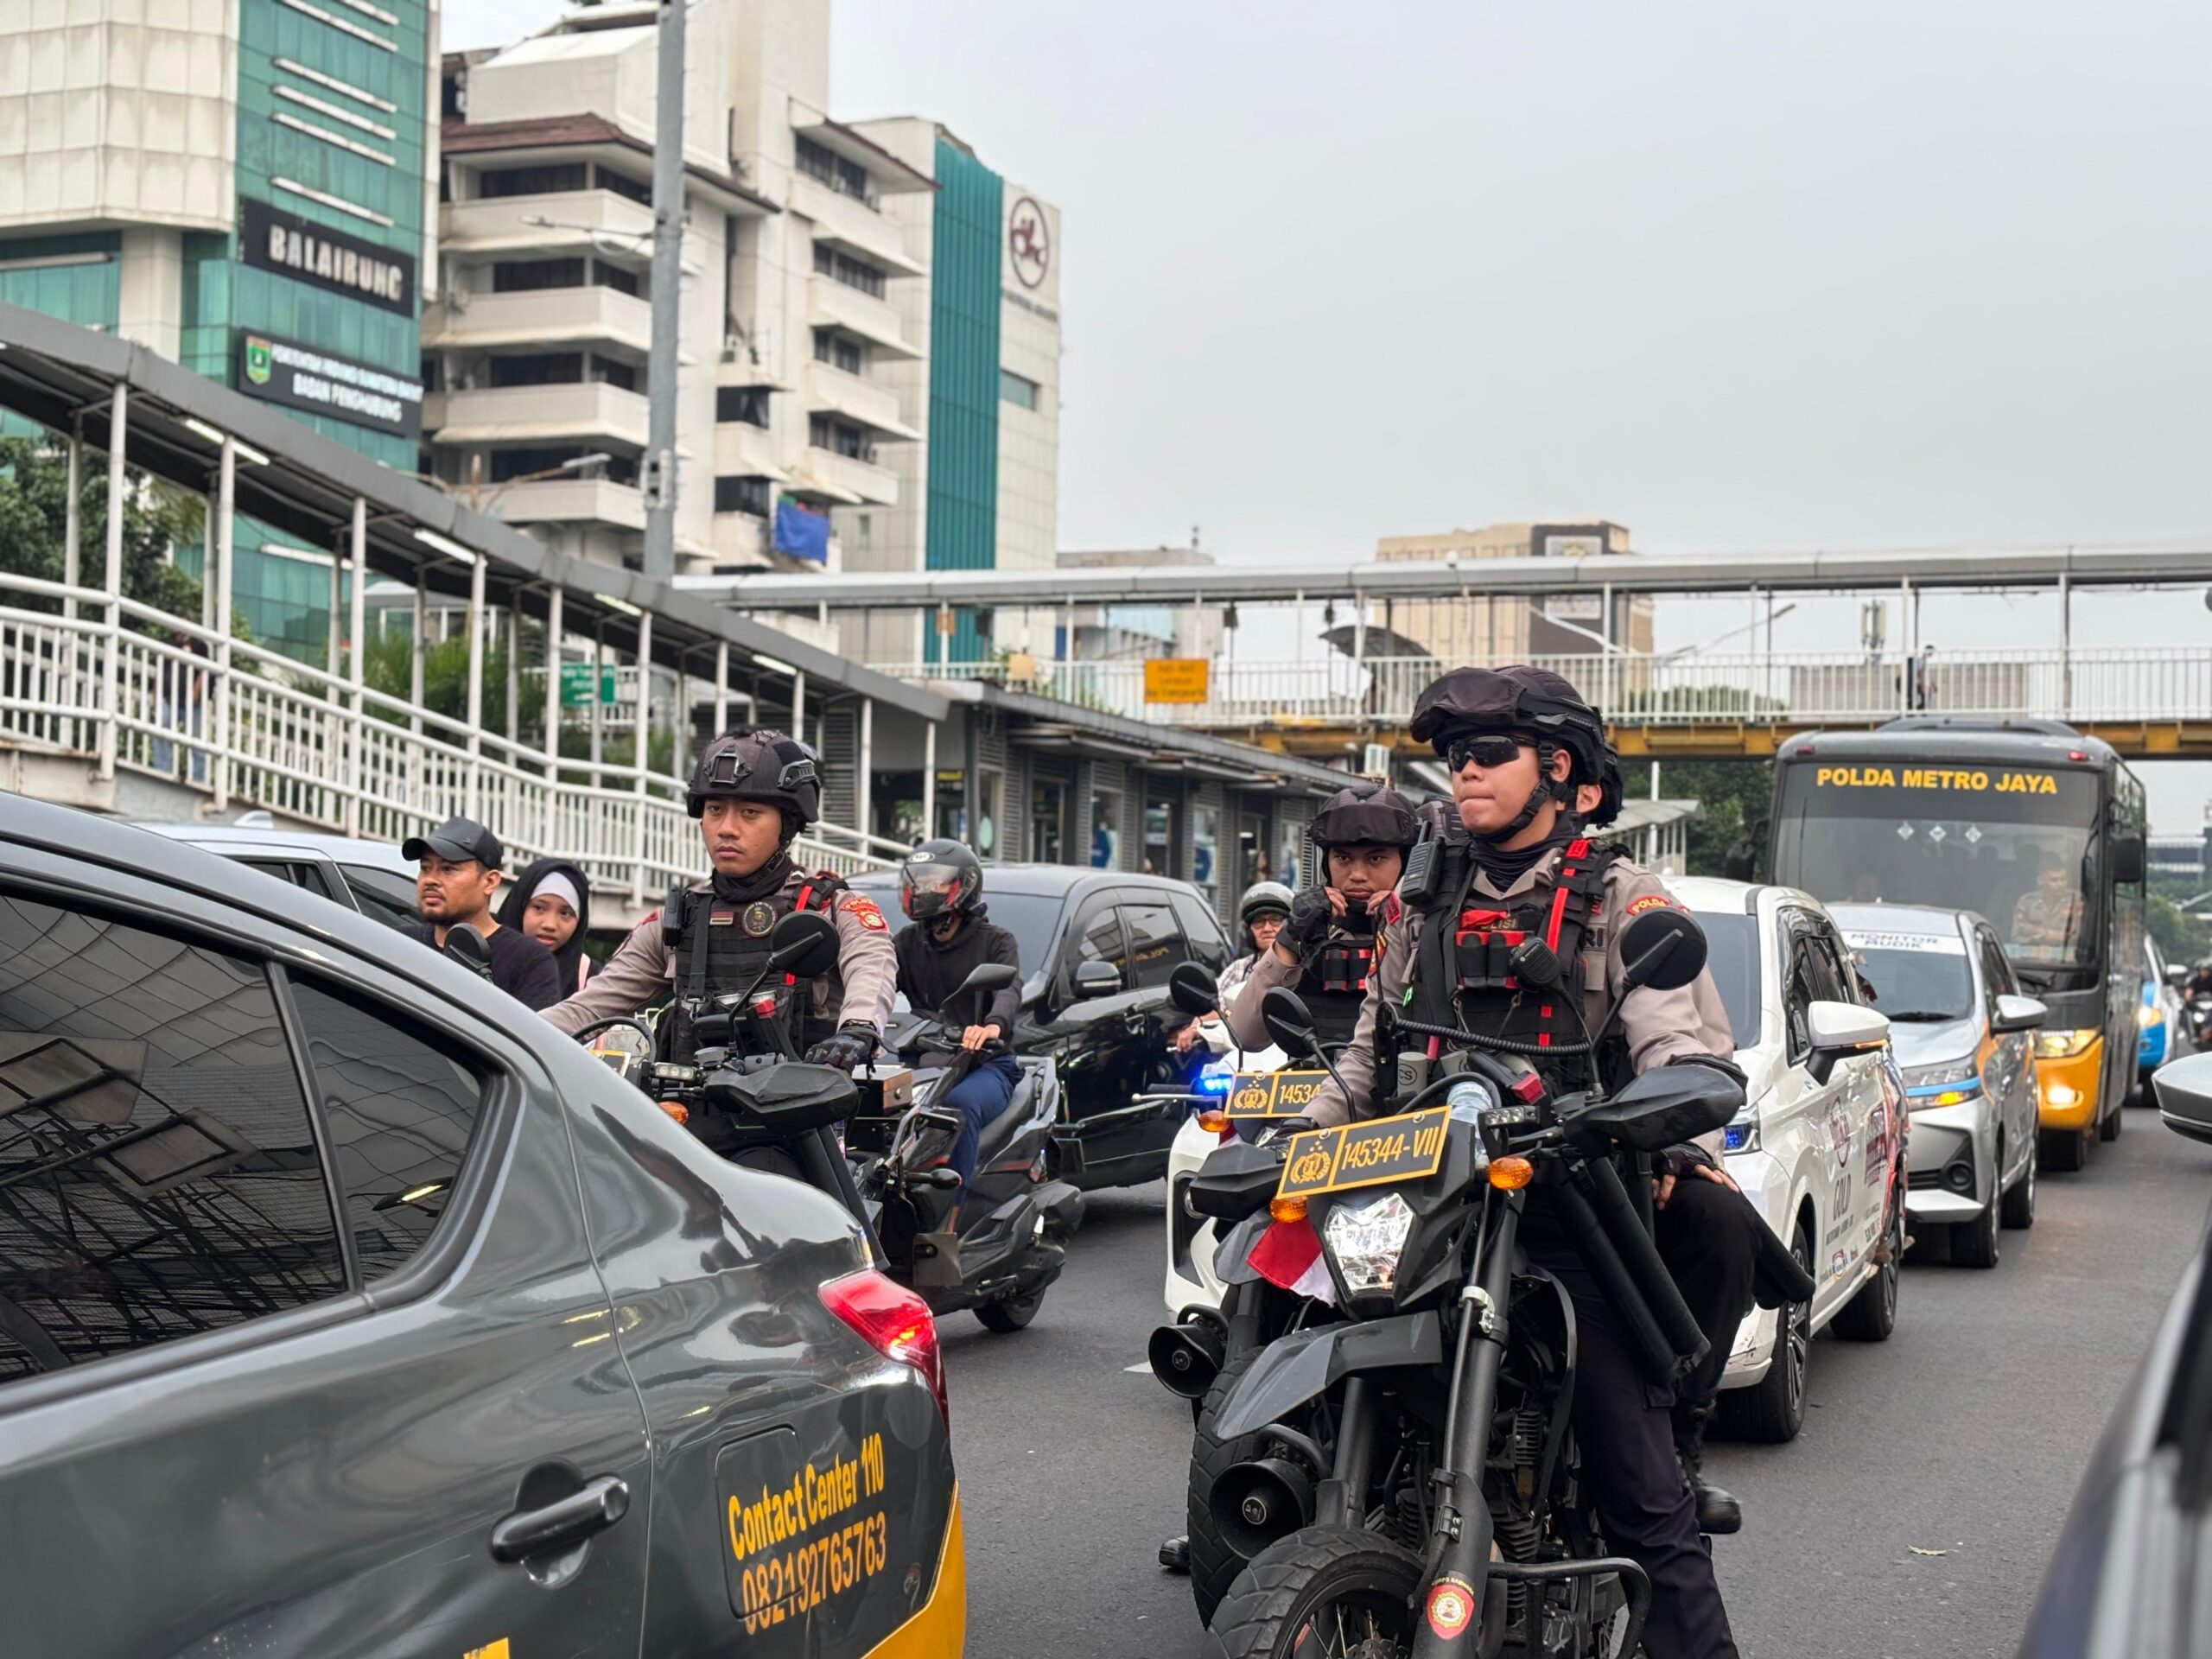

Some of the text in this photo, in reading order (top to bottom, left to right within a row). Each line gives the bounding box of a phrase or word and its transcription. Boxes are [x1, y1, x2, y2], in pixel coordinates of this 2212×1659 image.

[269, 224, 404, 302] BALAIRUNG
[1817, 768, 2057, 794] POLDA METRO JAYA
[1631, 899, 1667, 914] POLDA
[1852, 934, 1938, 944] MONITOR
[1341, 1127, 1440, 1171] 145344-VII
[1833, 1173, 1852, 1222] GOLD
[728, 1433, 885, 1560] Contact Center 110
[742, 1510, 887, 1636] 082192765763
